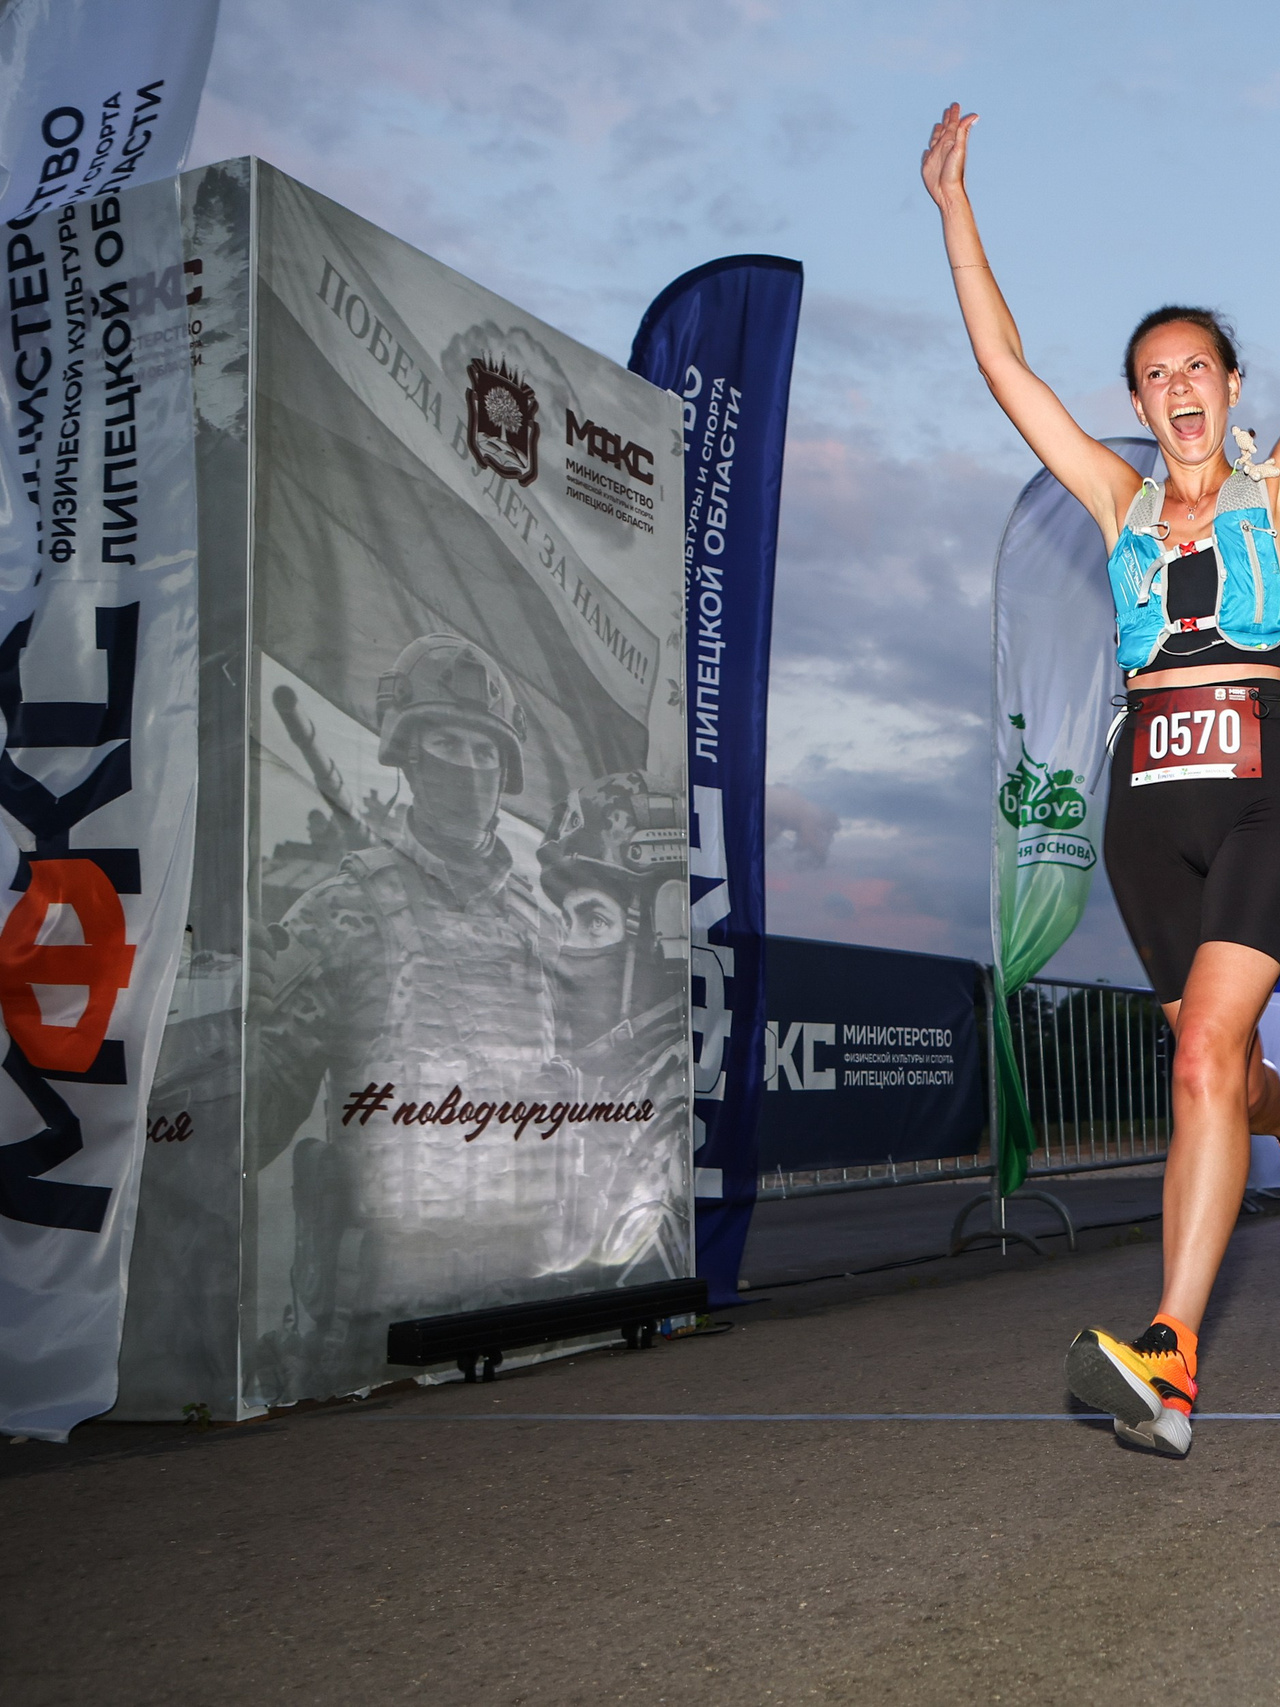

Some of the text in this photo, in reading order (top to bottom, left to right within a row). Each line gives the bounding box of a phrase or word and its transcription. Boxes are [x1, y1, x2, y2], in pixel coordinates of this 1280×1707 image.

[91, 79, 165, 268] ОБЛАСТИ
[49, 91, 122, 563] ФИЗИЧЕСКОЙ КУЛЬТУРЫ И СПОРТА
[90, 281, 141, 566] ЛИПЕЦКОЙ
[316, 254, 443, 435] ПОБЕДА
[451, 414, 538, 544] БДЕТ
[539, 533, 568, 592] ЗА
[566, 408, 654, 486] МФКС
[702, 378, 725, 462] СПОРТА
[566, 458, 654, 510] МИНИСТЕРСТВО
[697, 467, 709, 483] И
[704, 386, 742, 556] ОБЛАСТИ
[566, 486, 654, 534] ЛИПЕЦКОЙ ОБЛАСТИ
[696, 565, 726, 763] ЛИПЕЦКОЙ
[1149, 708, 1241, 760] 0570
[1035, 841, 1091, 862] ОСНОВА
[764, 1020, 952, 1091] КС МИНИСТЕРСТВО
[843, 1067, 954, 1089] ЛИПЕЦКОЙ ОБЛАСТИ
[844, 1052, 954, 1064] ФИЗИЧЕСКОЙ КУЛЬТУРЫ И СПОРТА
[342, 1081, 655, 1143] #поводгордиться
